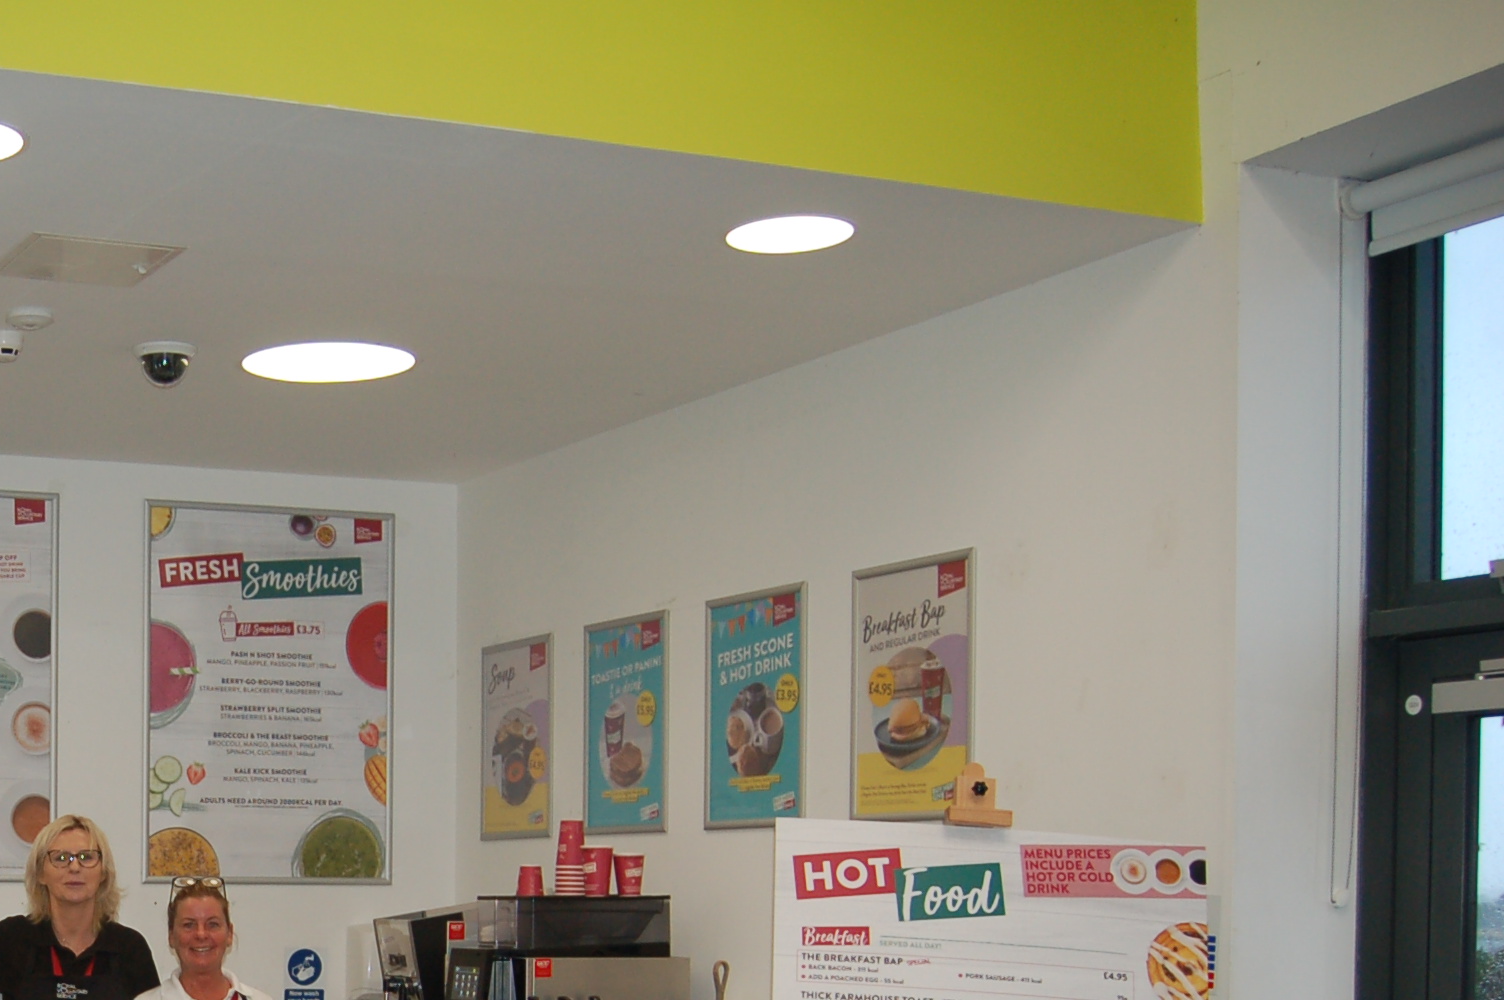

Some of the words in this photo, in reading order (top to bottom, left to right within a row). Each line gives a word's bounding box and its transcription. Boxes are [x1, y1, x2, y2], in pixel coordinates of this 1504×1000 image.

[165, 559, 240, 582] FRESH
[243, 563, 361, 599] Smoothies
[863, 608, 916, 643] Breakfast
[921, 599, 945, 628] Bap
[239, 624, 250, 635] All
[253, 624, 291, 636] Smoothies
[297, 625, 320, 634] £3.75
[870, 642, 884, 653] AND
[886, 634, 916, 648] REGULAR
[918, 628, 940, 641] DRINK
[718, 645, 751, 667] FRESH
[754, 633, 793, 658] SCONE
[592, 670, 621, 685] TOASTIE
[622, 664, 632, 676] OR
[635, 656, 662, 671] PANINI
[720, 671, 727, 686] &
[730, 663, 752, 681] HOT
[756, 652, 791, 675] DRINK
[489, 664, 514, 695] Soup
[776, 689, 797, 701] £3.95
[869, 683, 892, 695] £4.95
[1024, 849, 1063, 858] MENU
[1067, 849, 1110, 859] PRICES
[1025, 861, 1082, 870] INCLUDE
[1085, 862, 1094, 870] A
[1027, 872, 1054, 882] HOT
[1057, 873, 1075, 882] OR
[1078, 873, 1114, 882] COLD
[803, 857, 889, 891] HOT
[902, 867, 1000, 921] Food
[1028, 884, 1070, 893] DRINK
[803, 927, 868, 945] Breakfast
[802, 953, 821, 961] THE
[824, 954, 880, 963] BREAKFAST
[884, 957, 903, 965] BAP
[1104, 972, 1127, 981] £4.95
[801, 991, 832, 1000] THICK
